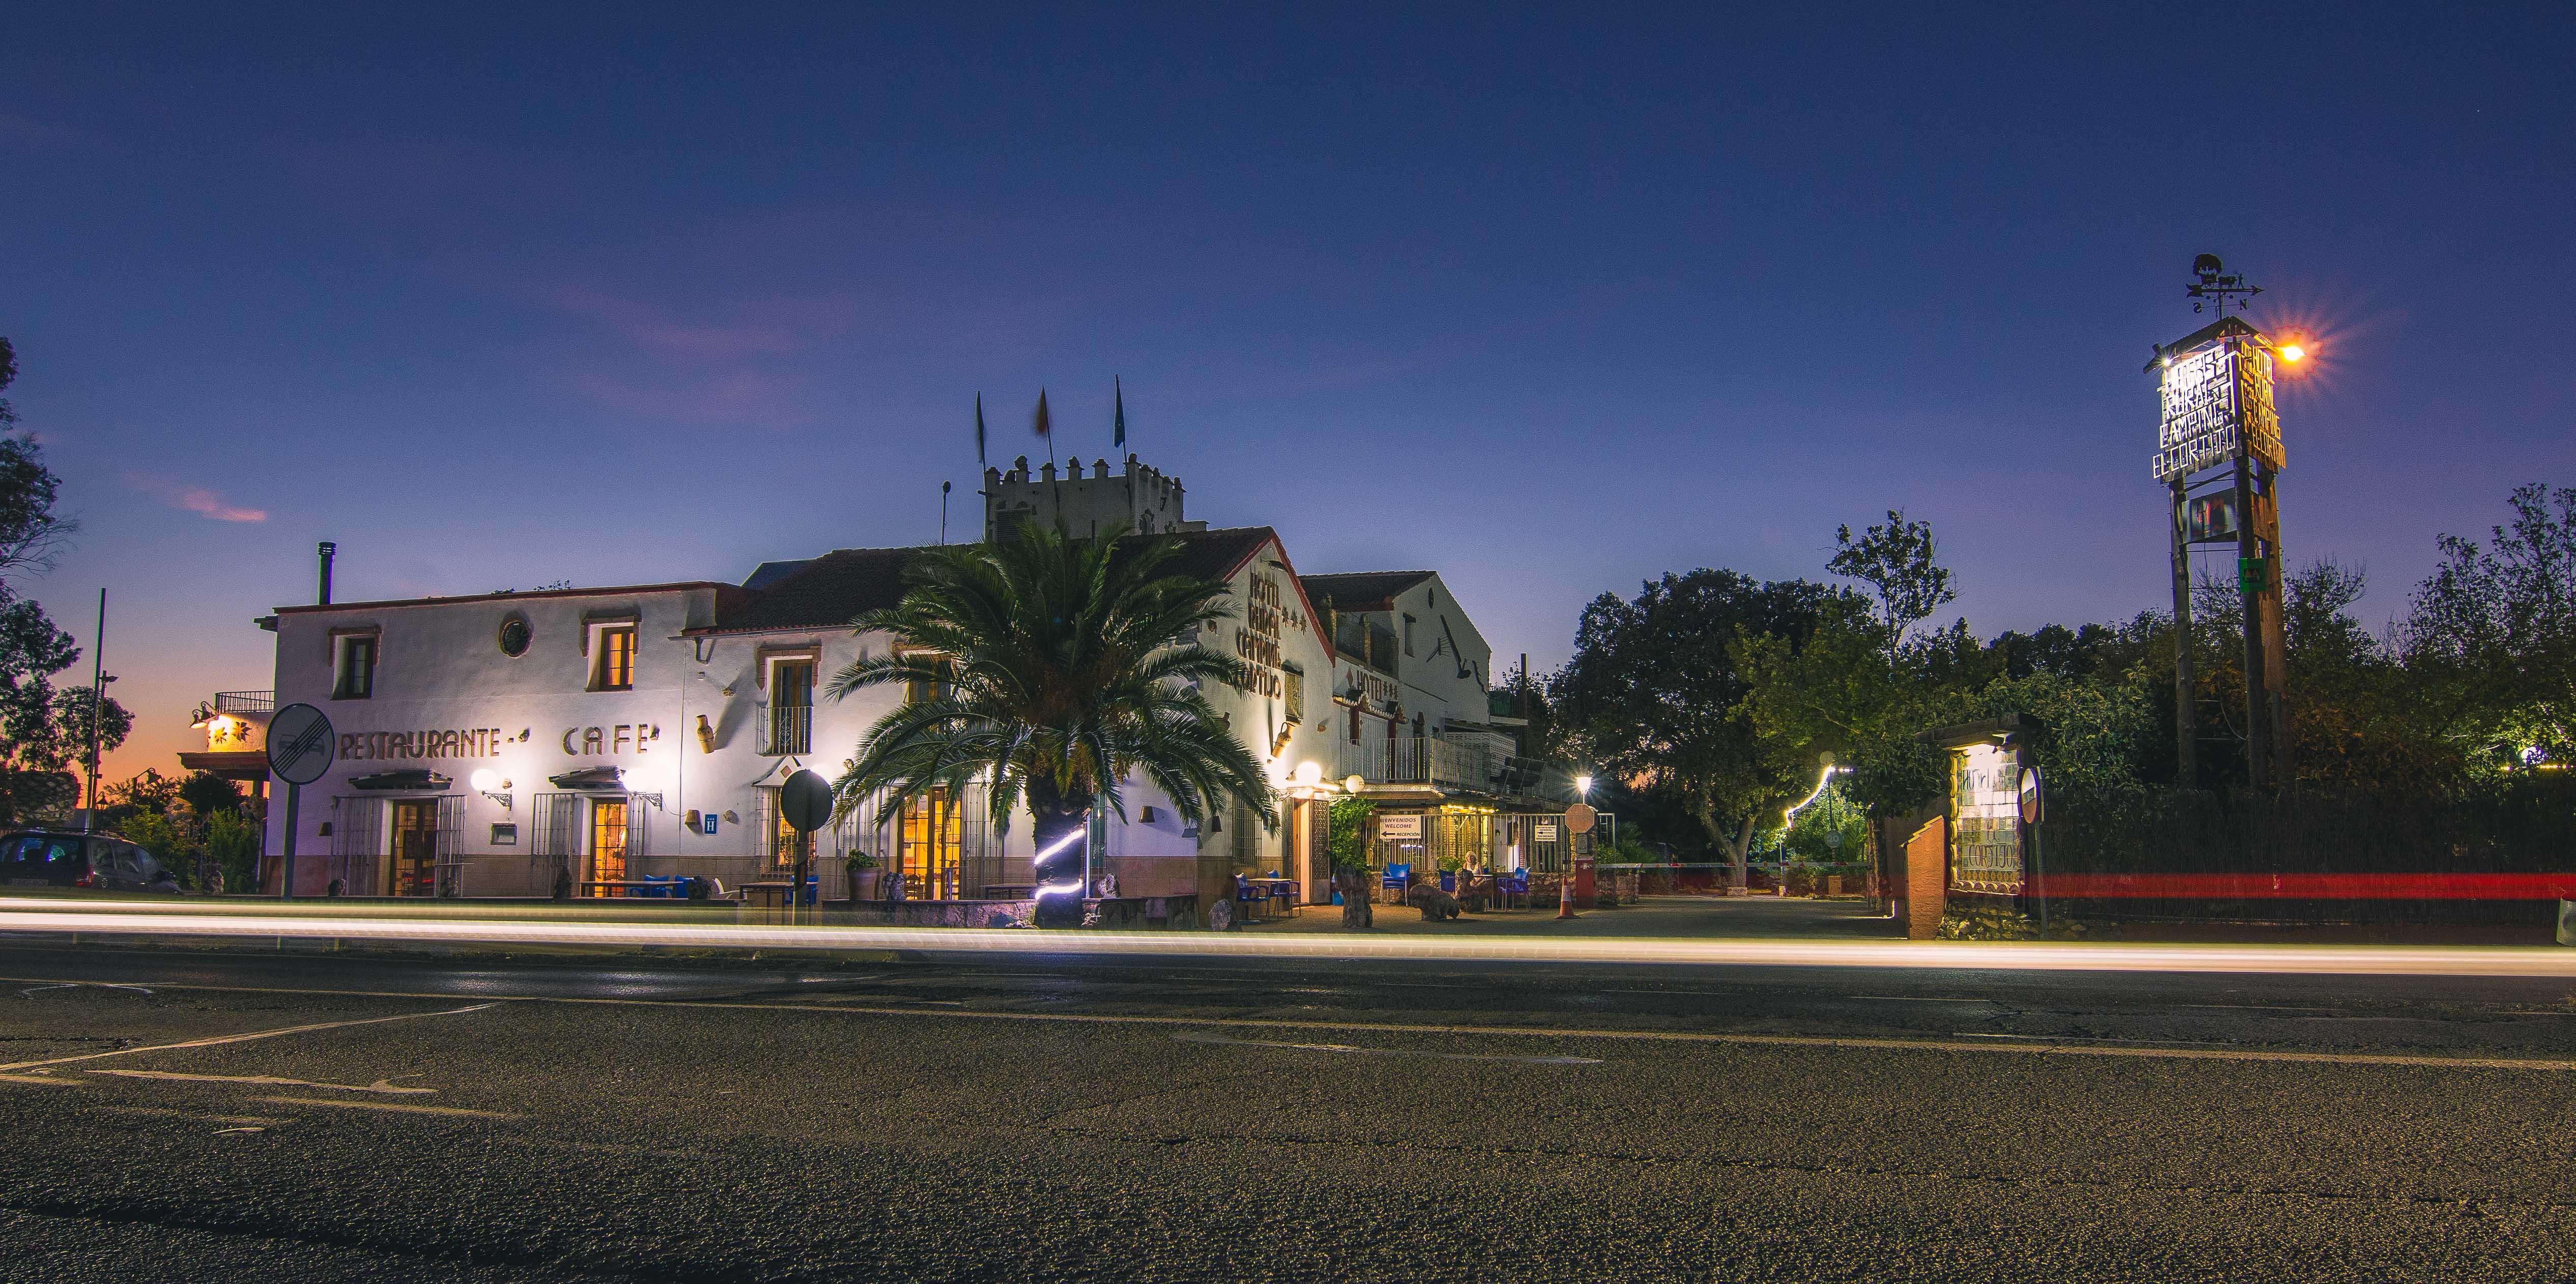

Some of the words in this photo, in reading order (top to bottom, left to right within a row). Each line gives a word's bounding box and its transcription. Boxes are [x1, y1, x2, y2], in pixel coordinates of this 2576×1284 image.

[2252, 345, 2275, 385] HOTEL
[2160, 400, 2225, 449] CAMPING
[1250, 572, 1281, 610] HOTEL
[1248, 603, 1281, 640] RURAL
[1237, 631, 1281, 670] CAMPING
[1357, 670, 1384, 703] HOTEL
[341, 728, 500, 760] RESTAURANTE
[707, 821, 715, 831] H
[1969, 845, 2013, 868] CORTIJO
